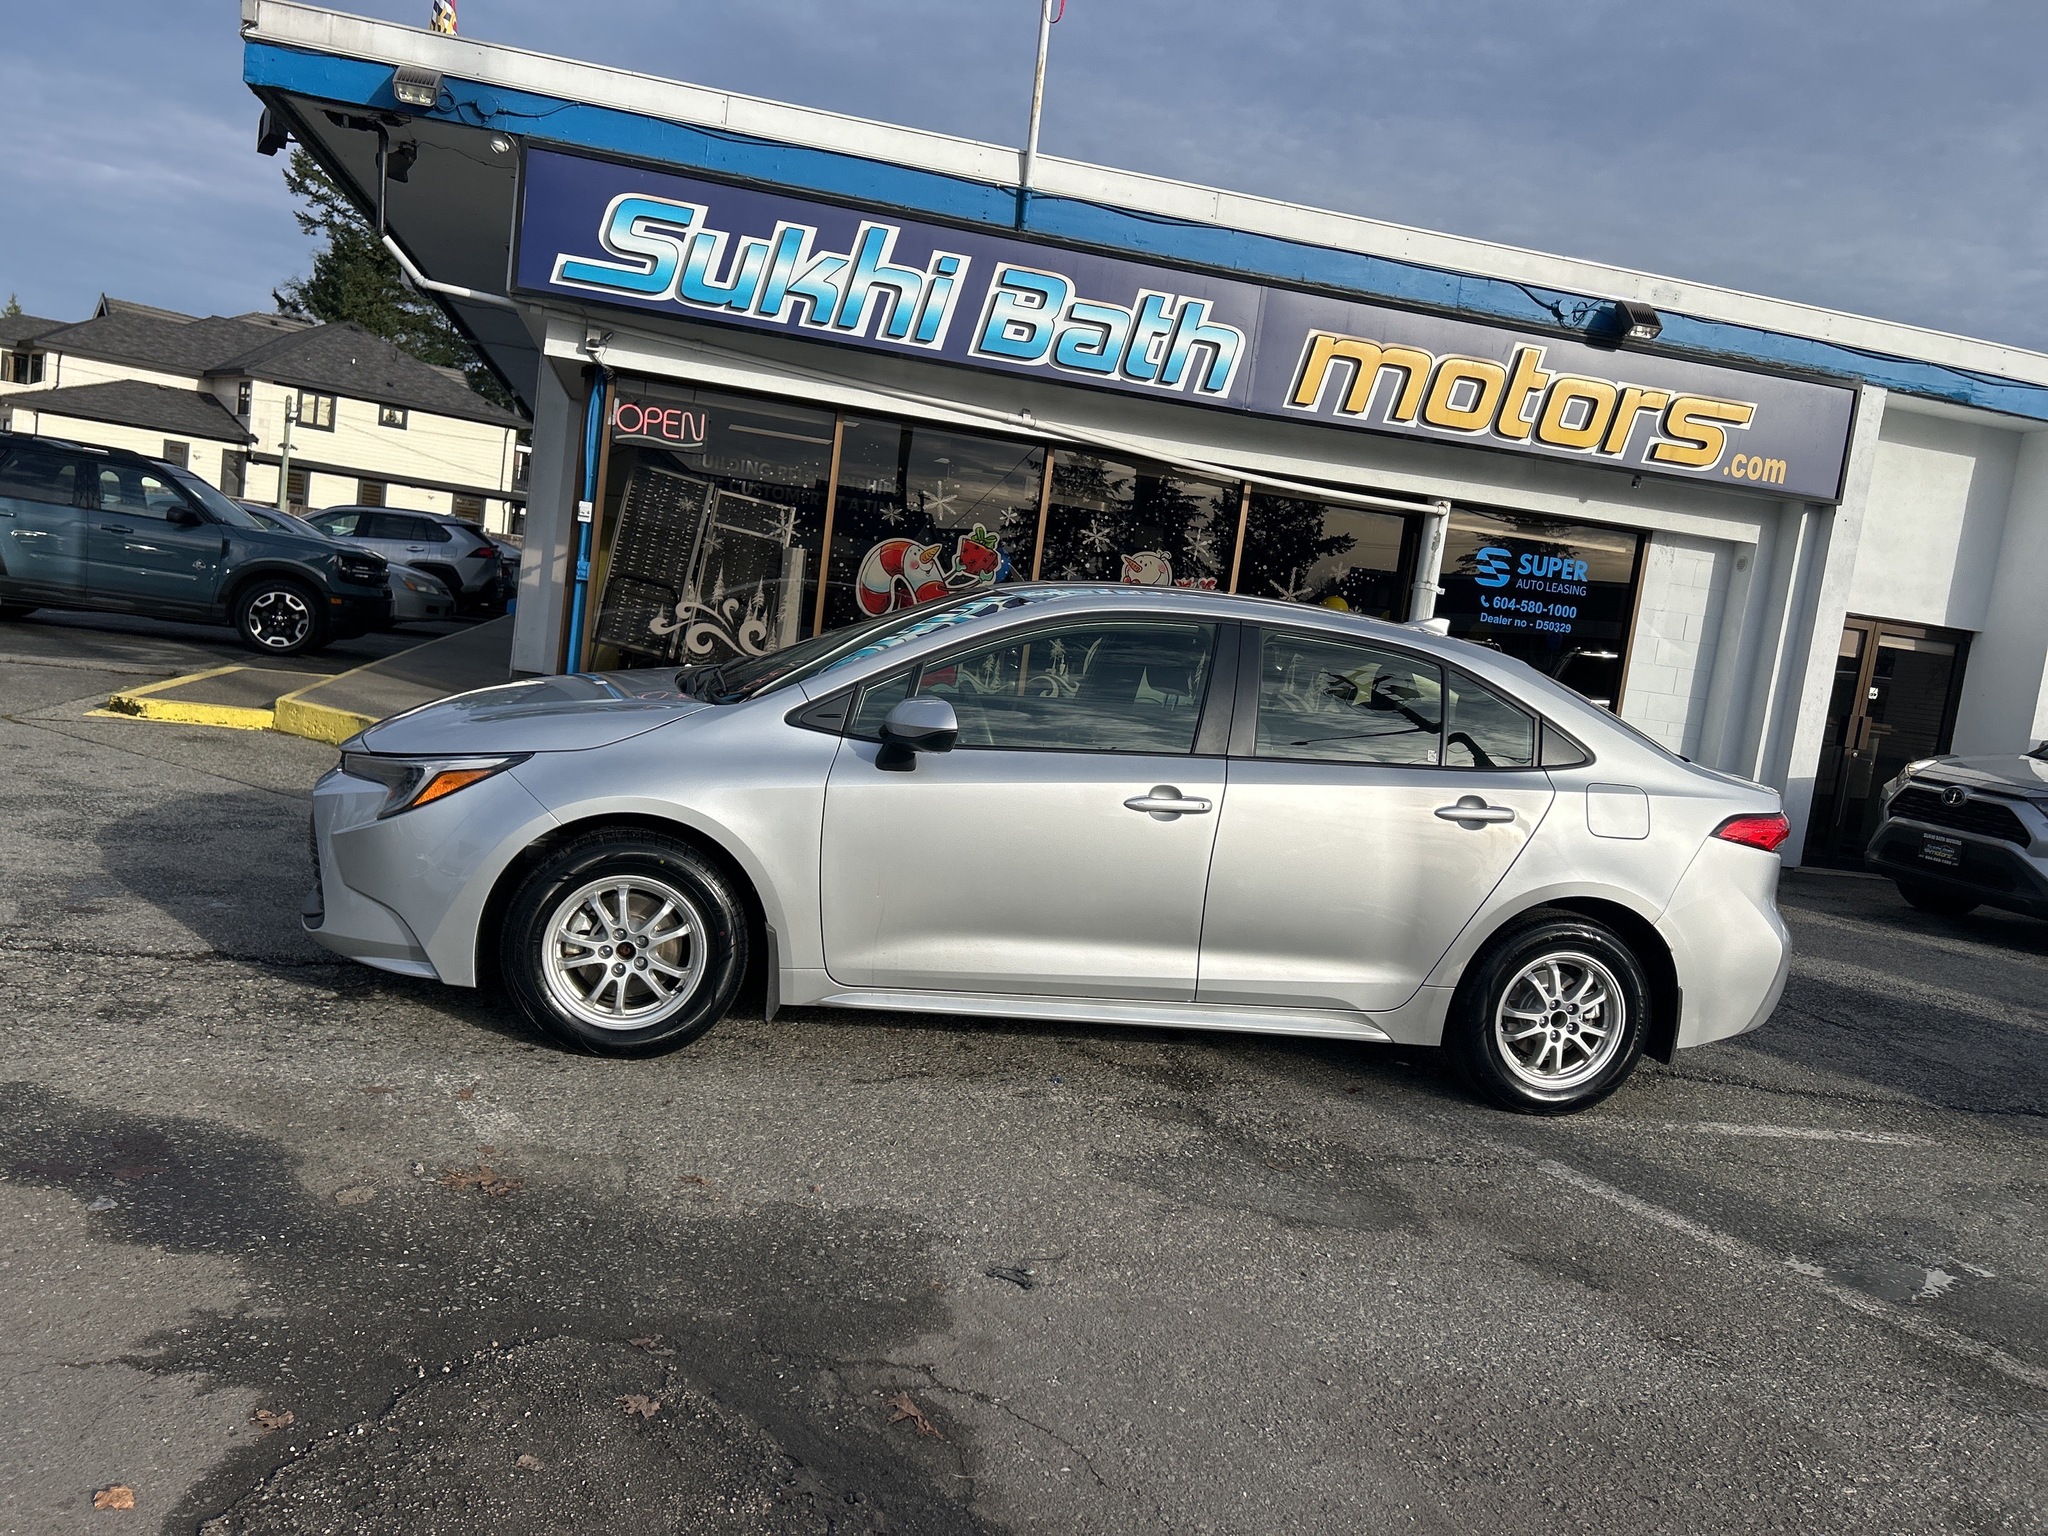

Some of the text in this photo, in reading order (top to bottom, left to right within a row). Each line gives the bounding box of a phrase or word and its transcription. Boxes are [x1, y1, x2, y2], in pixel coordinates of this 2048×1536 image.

[550, 193, 970, 351] Sukhi
[970, 262, 1247, 399] Bath
[1284, 329, 1759, 472] motors
[615, 403, 705, 441] OPEN
[1517, 553, 1588, 582] SUPER
[1515, 579, 1587, 597] AUTO LEASING
[1492, 596, 1577, 619] 604-580-1000
[1480, 612, 1512, 626] Dealer
[1514, 619, 1527, 628] no
[1535, 620, 1571, 633] D50329
